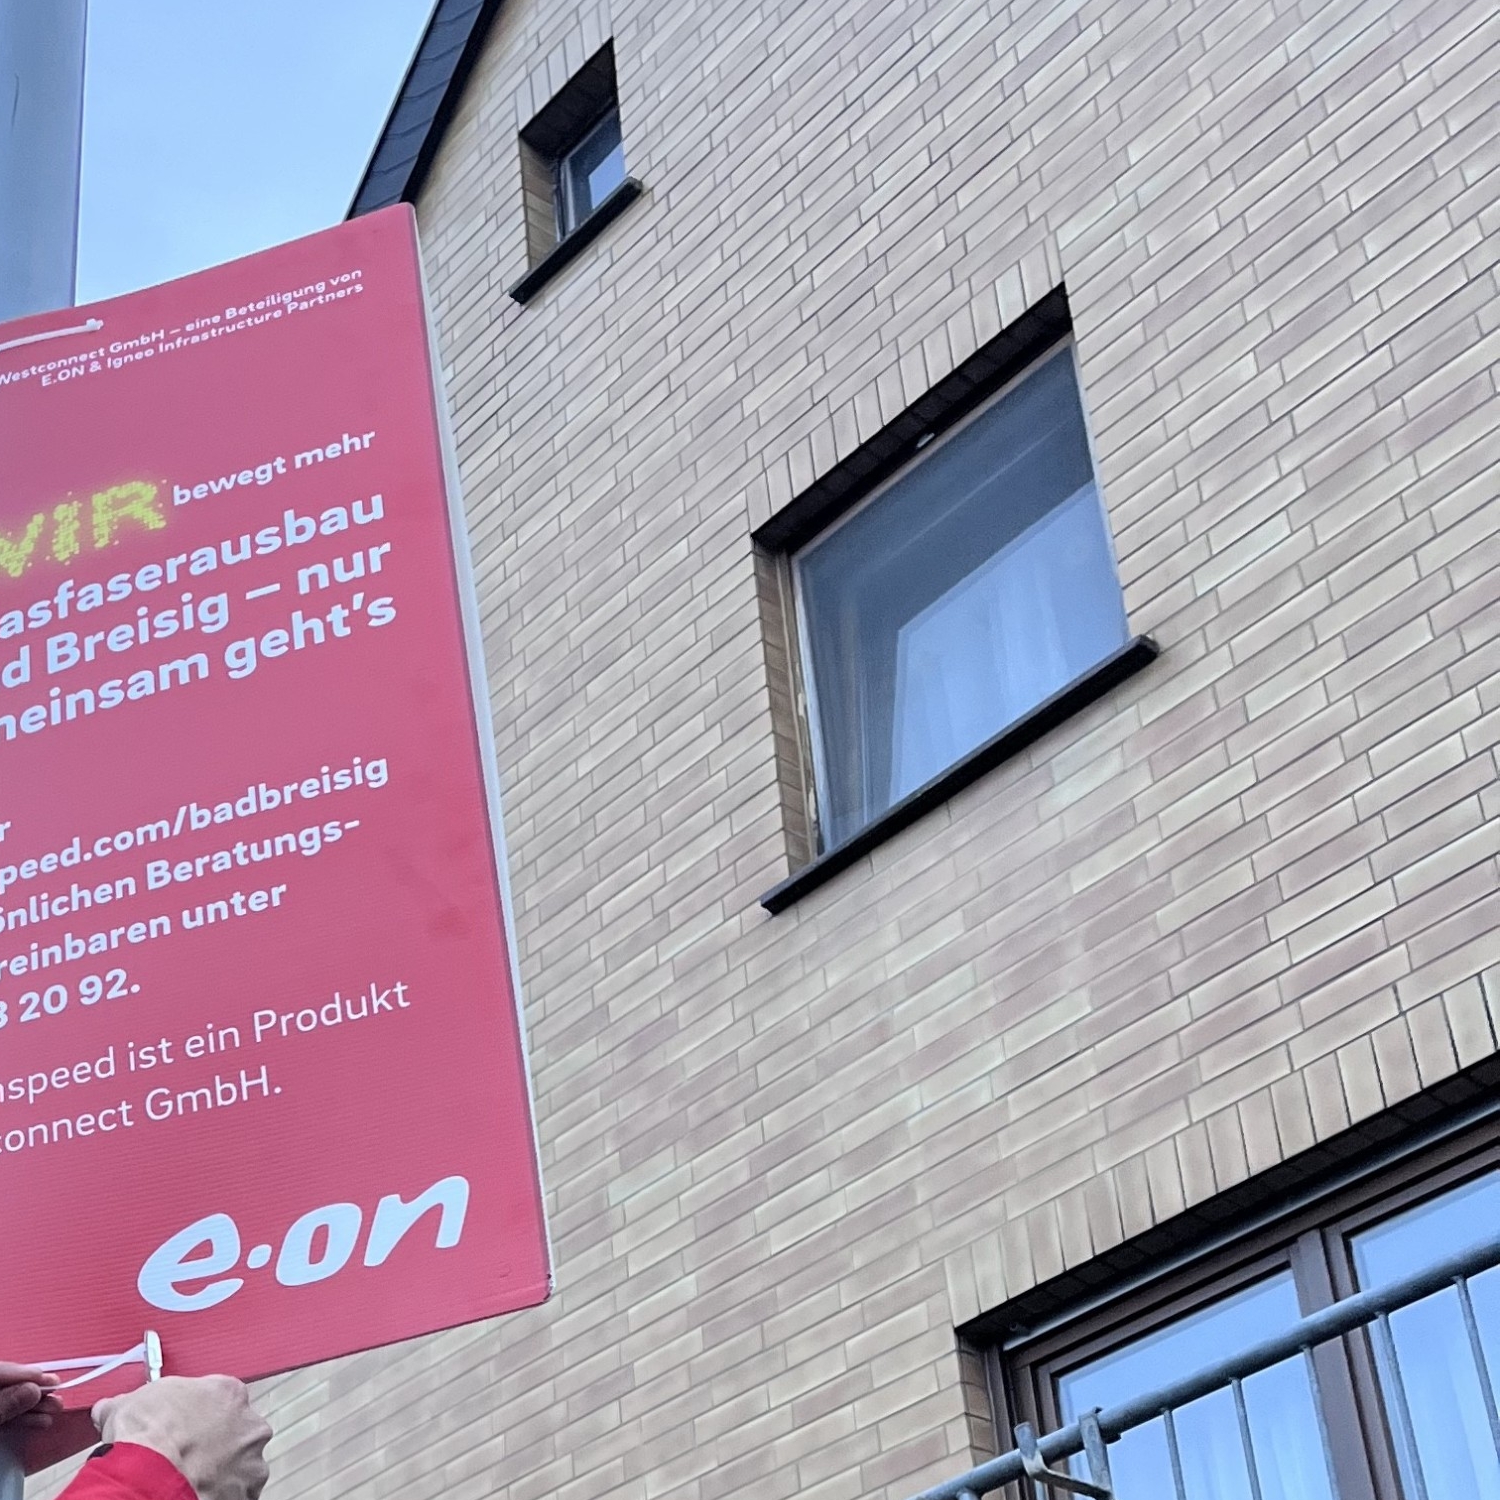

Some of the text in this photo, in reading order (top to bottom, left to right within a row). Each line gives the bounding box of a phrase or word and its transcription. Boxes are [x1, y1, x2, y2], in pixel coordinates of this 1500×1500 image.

[41, 283, 364, 387] E.ON & Igneo Infrastructure Partners
[109, 329, 165, 354] GmbH
[184, 314, 222, 334] eine
[225, 281, 326, 319] Beteiligung
[329, 269, 362, 286] von
[172, 456, 287, 506] bewegt
[294, 431, 376, 469] mehr
[46, 592, 229, 675] Breisig
[297, 541, 391, 595] nur
[146, 819, 360, 891] Beratungs-
[181, 883, 287, 930] unter
[18, 984, 68, 1023] 20
[78, 968, 141, 1006] 92.
[127, 1037, 174, 1072] ist
[185, 1023, 240, 1058] ein
[253, 981, 411, 1043] Produkt
[145, 1065, 282, 1121] GmbH.
